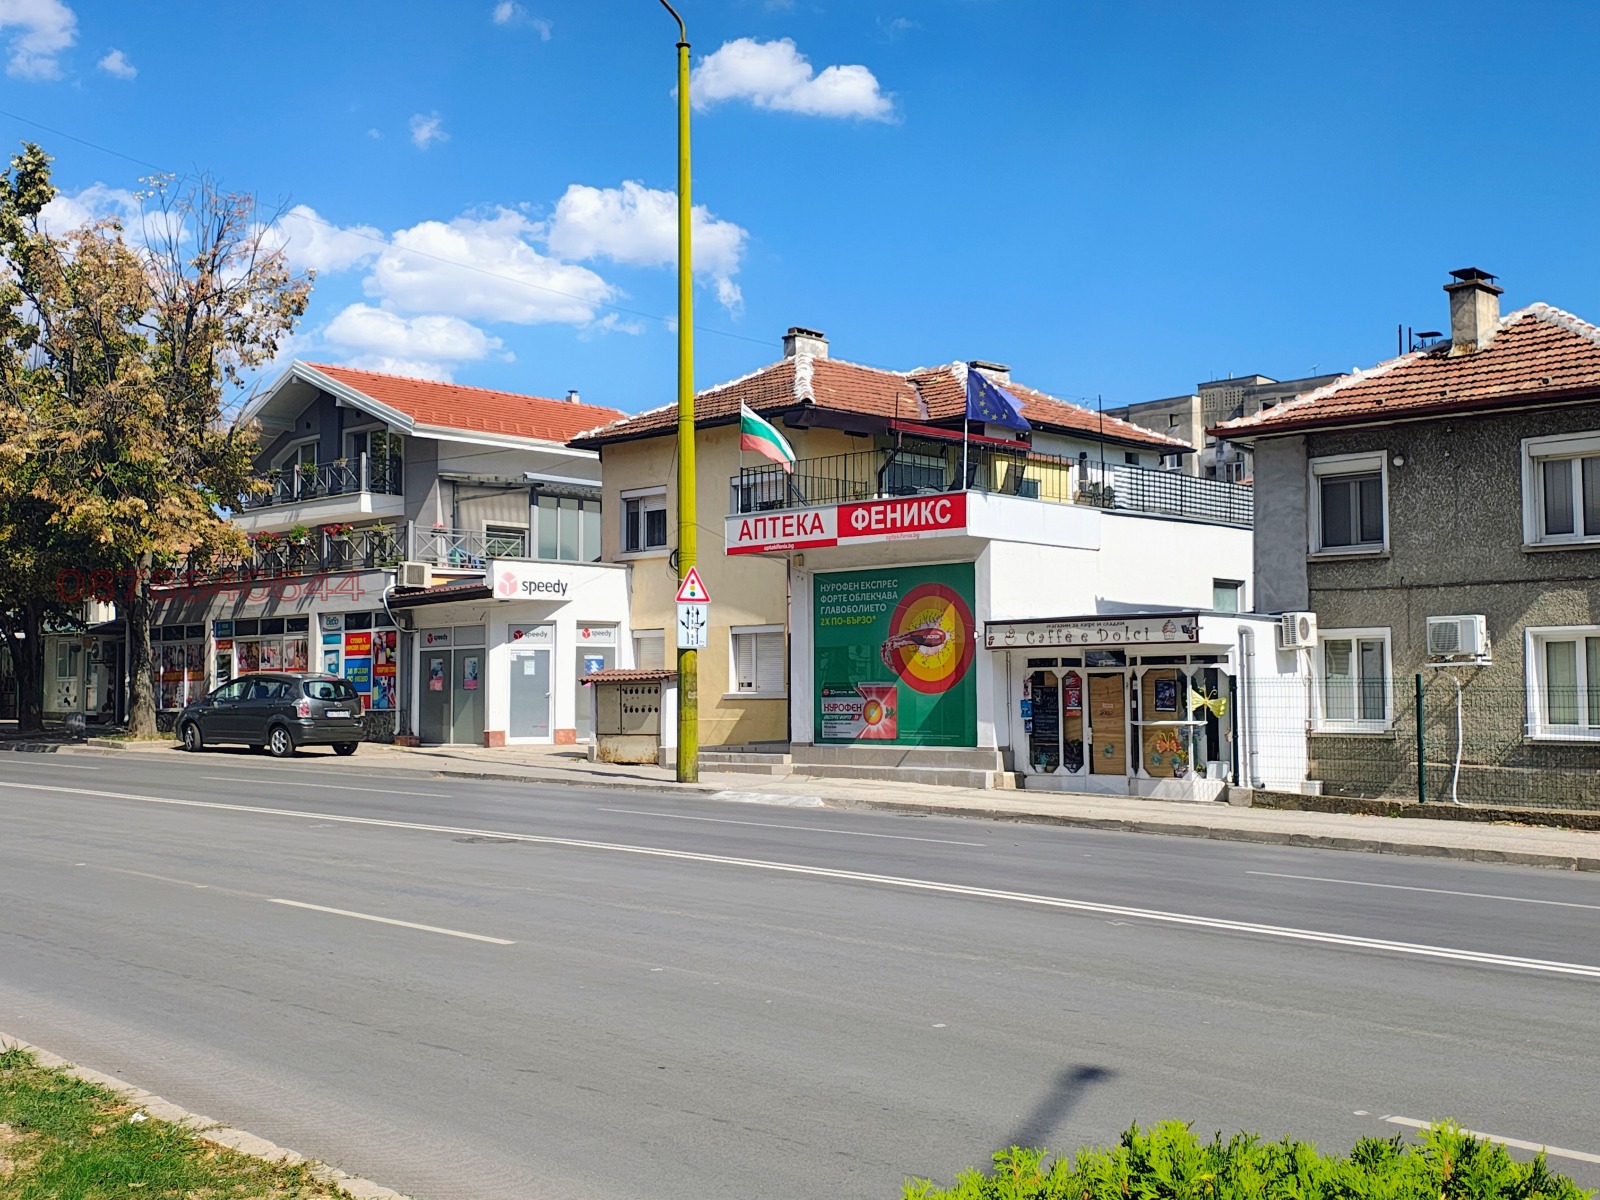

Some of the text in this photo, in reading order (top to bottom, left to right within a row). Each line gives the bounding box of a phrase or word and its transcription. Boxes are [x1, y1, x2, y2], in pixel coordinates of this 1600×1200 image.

[738, 499, 952, 541] АПТЕКА ФЕНИКС
[521, 579, 568, 596] speedy
[820, 579, 898, 592] НУРОФЕН ЕКСПРЕС
[820, 591, 899, 603] ФОРТЕ ОБЛЕКЧАВА
[820, 603, 887, 615] ГЛАВОБОЛИЕТО
[524, 630, 548, 641] speedy
[591, 629, 612, 640] speedy
[1096, 626, 1150, 642] Dolci
[823, 703, 862, 712] НУРОФЕН
